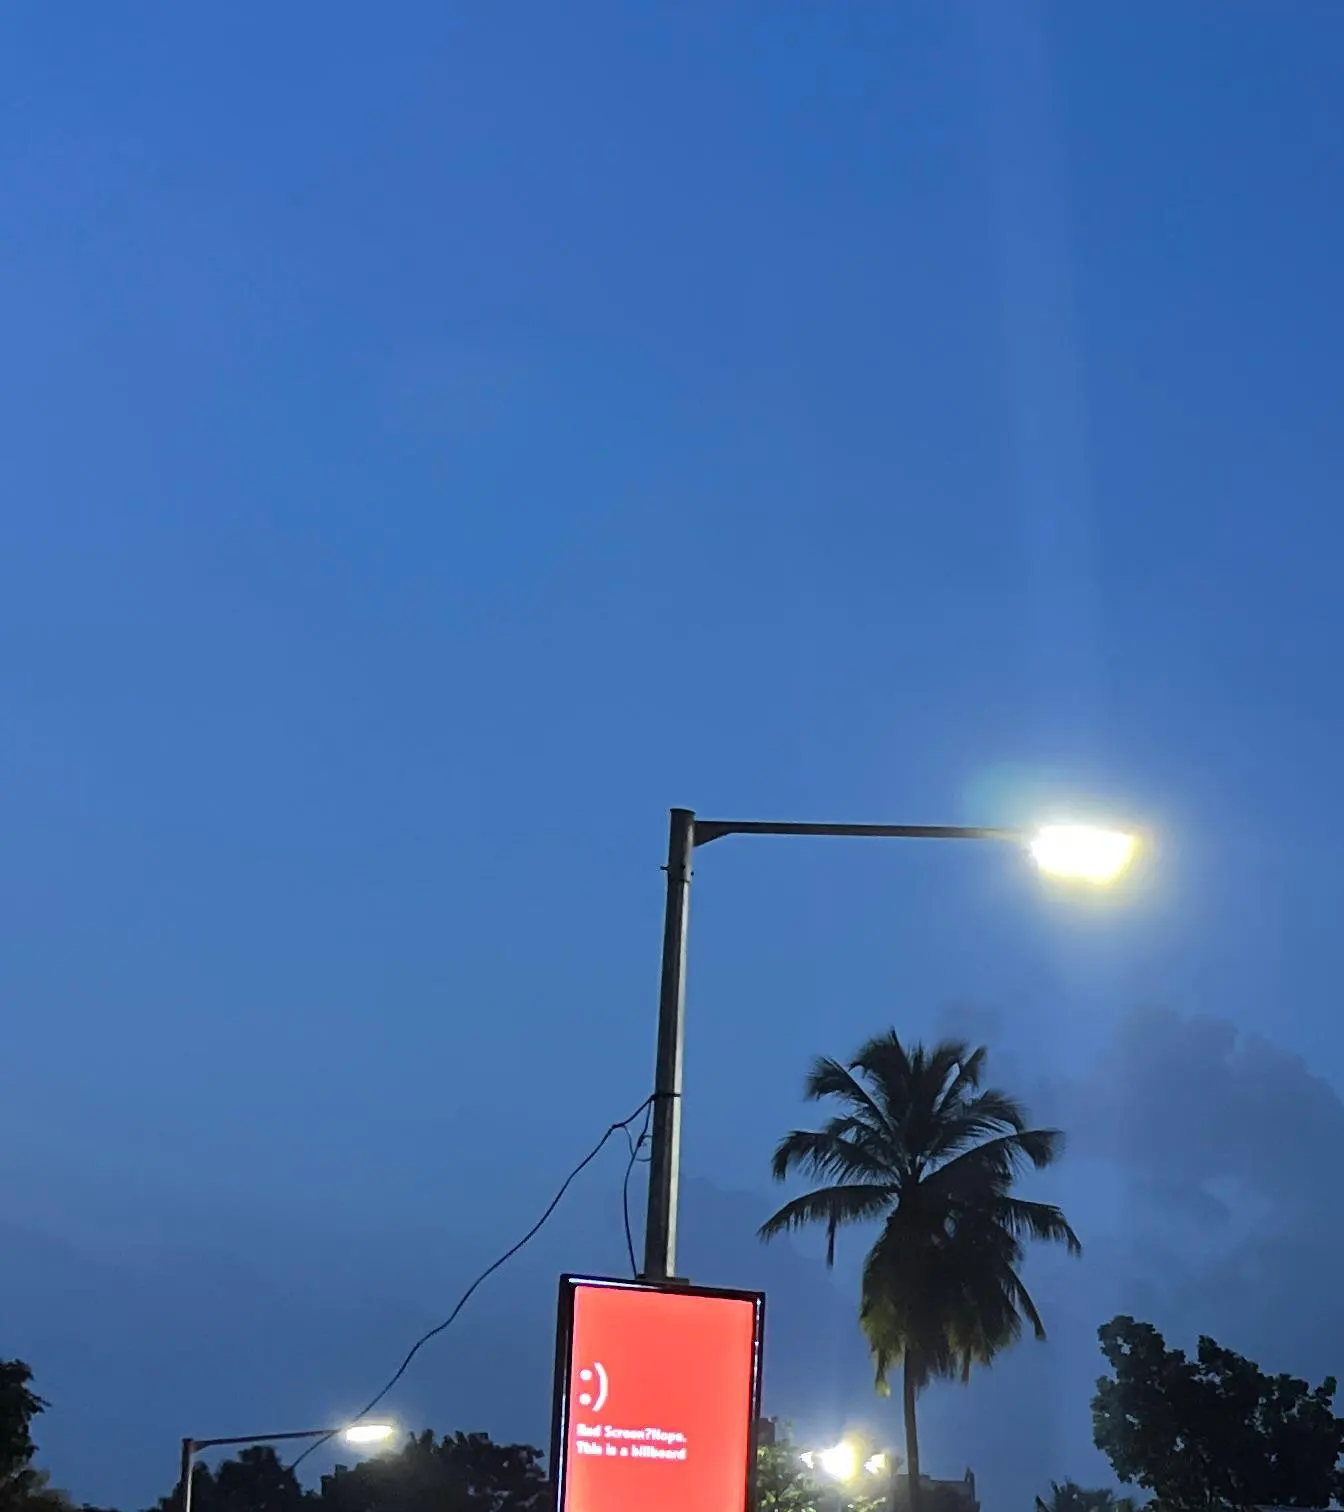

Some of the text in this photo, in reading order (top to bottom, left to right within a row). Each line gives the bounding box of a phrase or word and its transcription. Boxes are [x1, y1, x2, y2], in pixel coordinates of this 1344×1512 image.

[576, 1440, 687, 1460] This is a billboard
